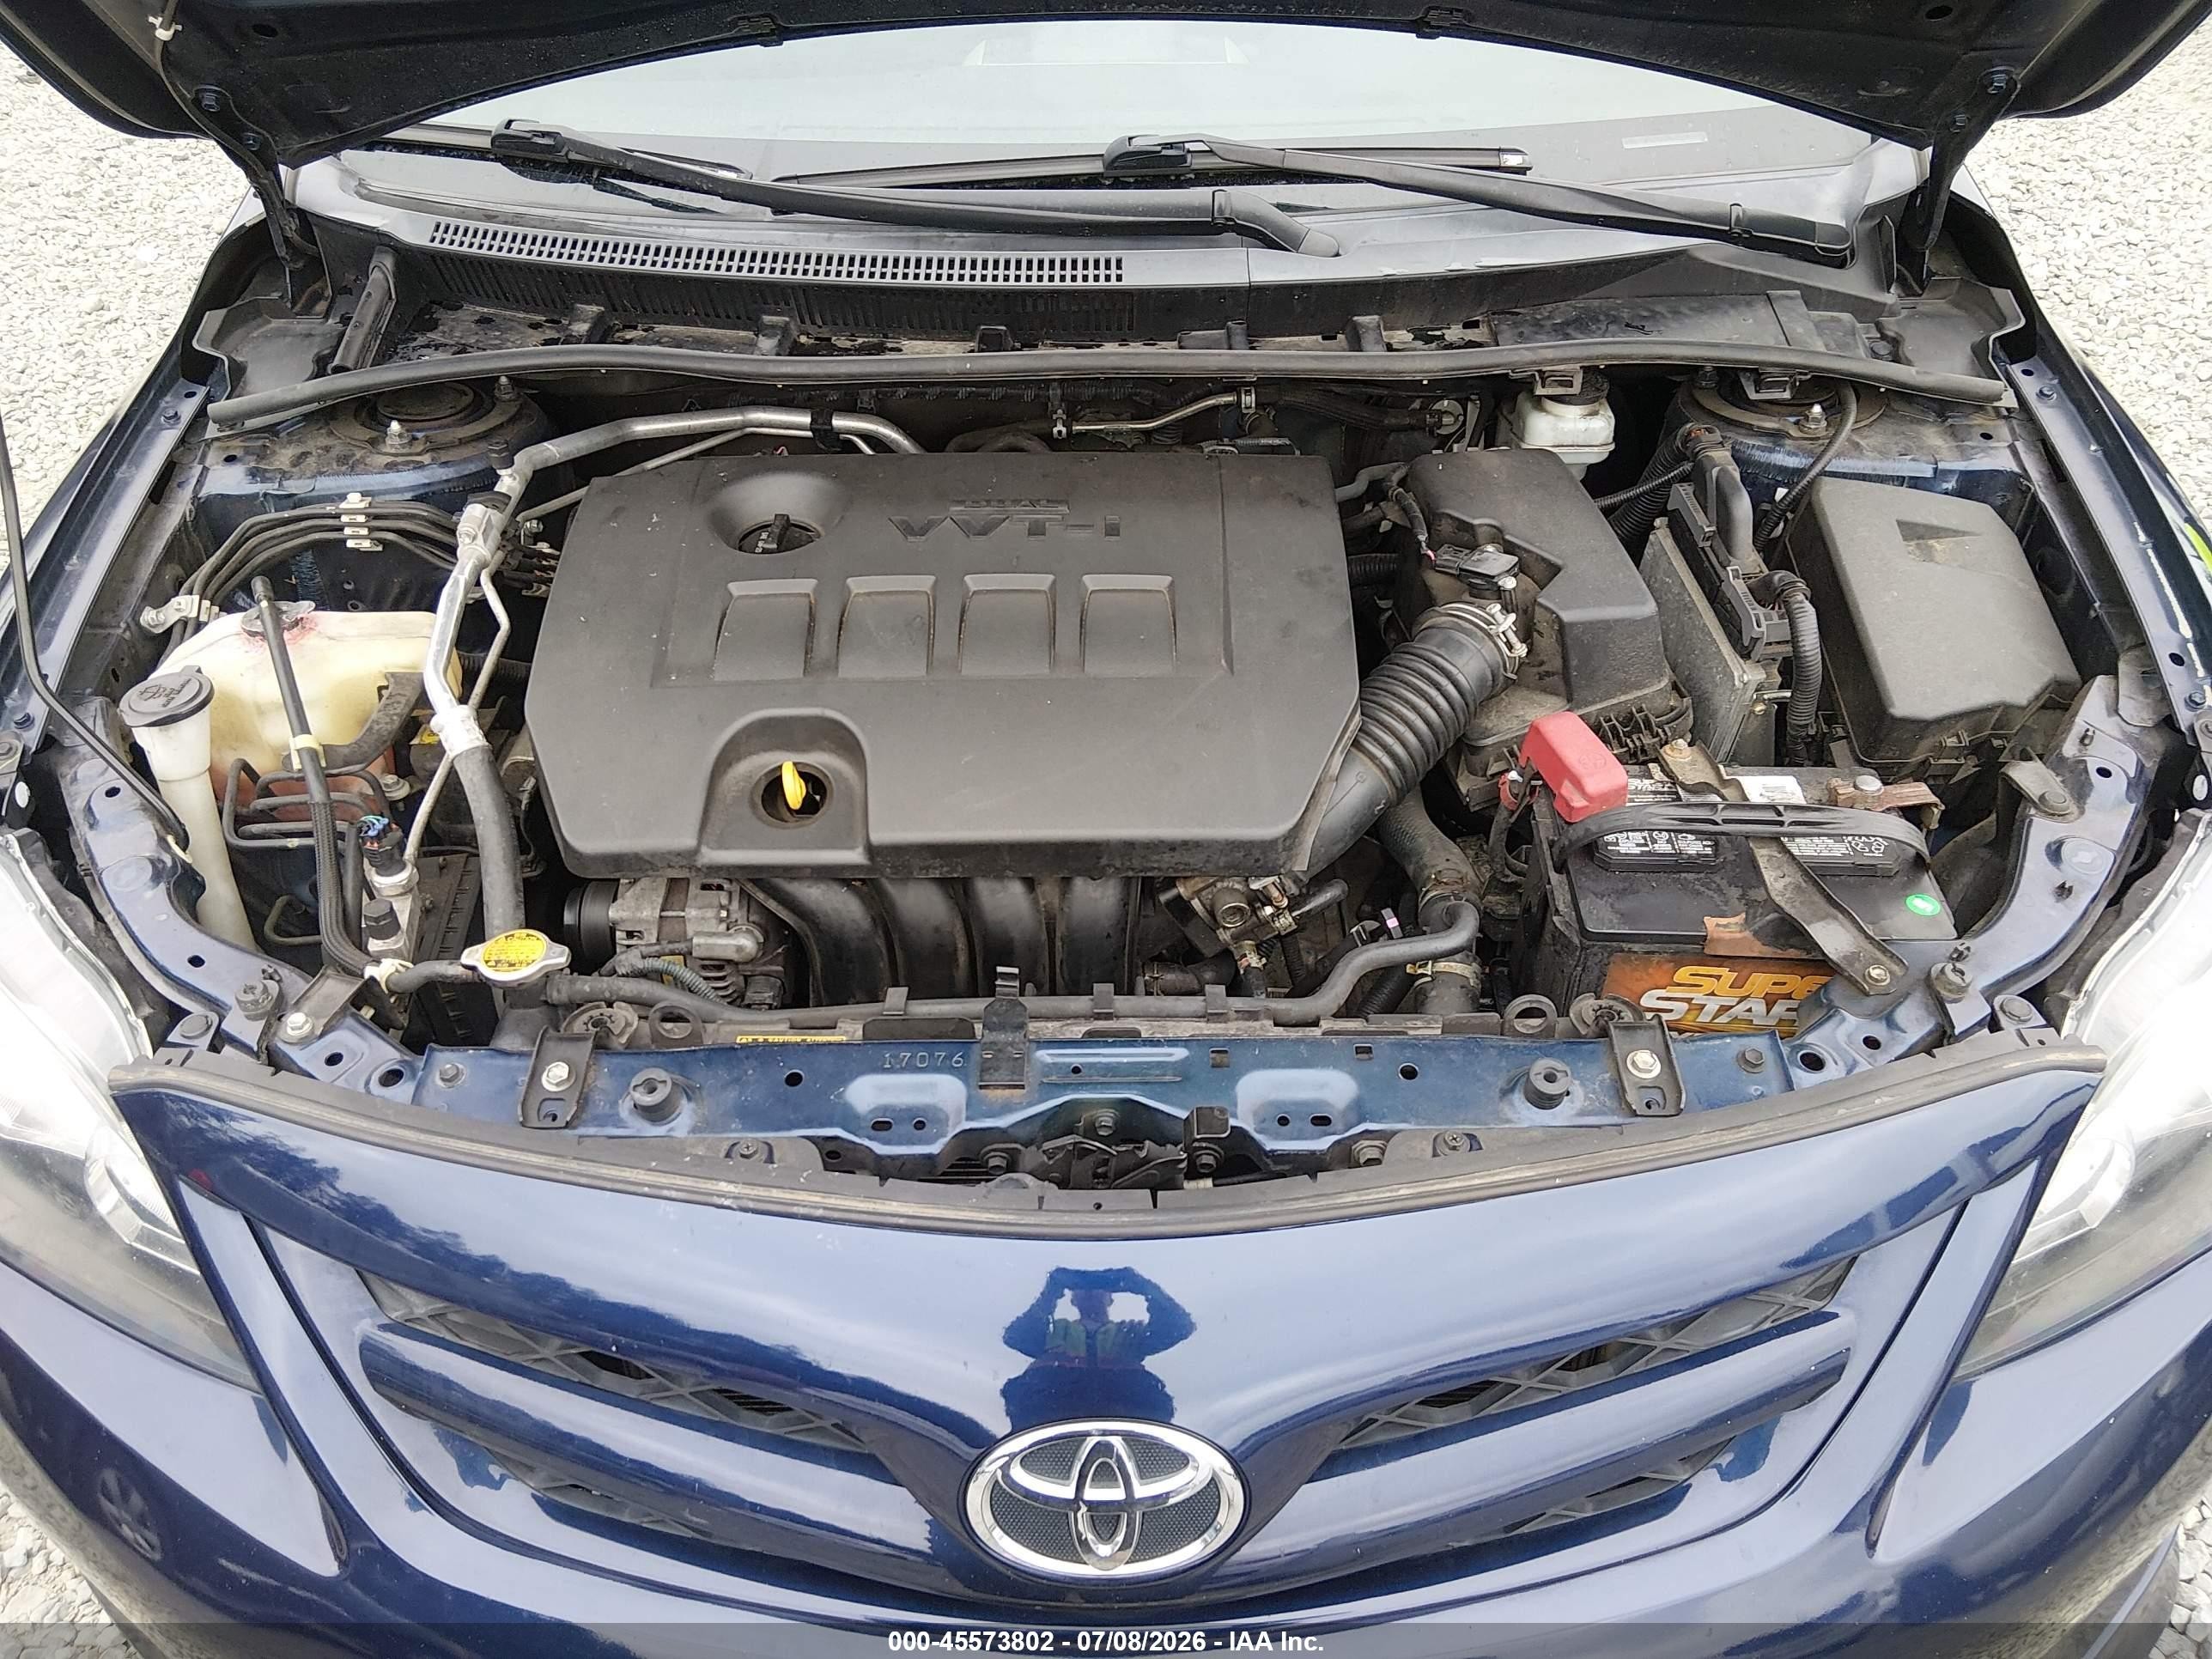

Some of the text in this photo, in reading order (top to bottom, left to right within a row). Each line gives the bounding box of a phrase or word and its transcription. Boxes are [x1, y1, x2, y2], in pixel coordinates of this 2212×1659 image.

[1665, 965, 1834, 1000] SUPE
[1639, 989, 1800, 1026] STAR
[883, 1051, 964, 1069] 17076
